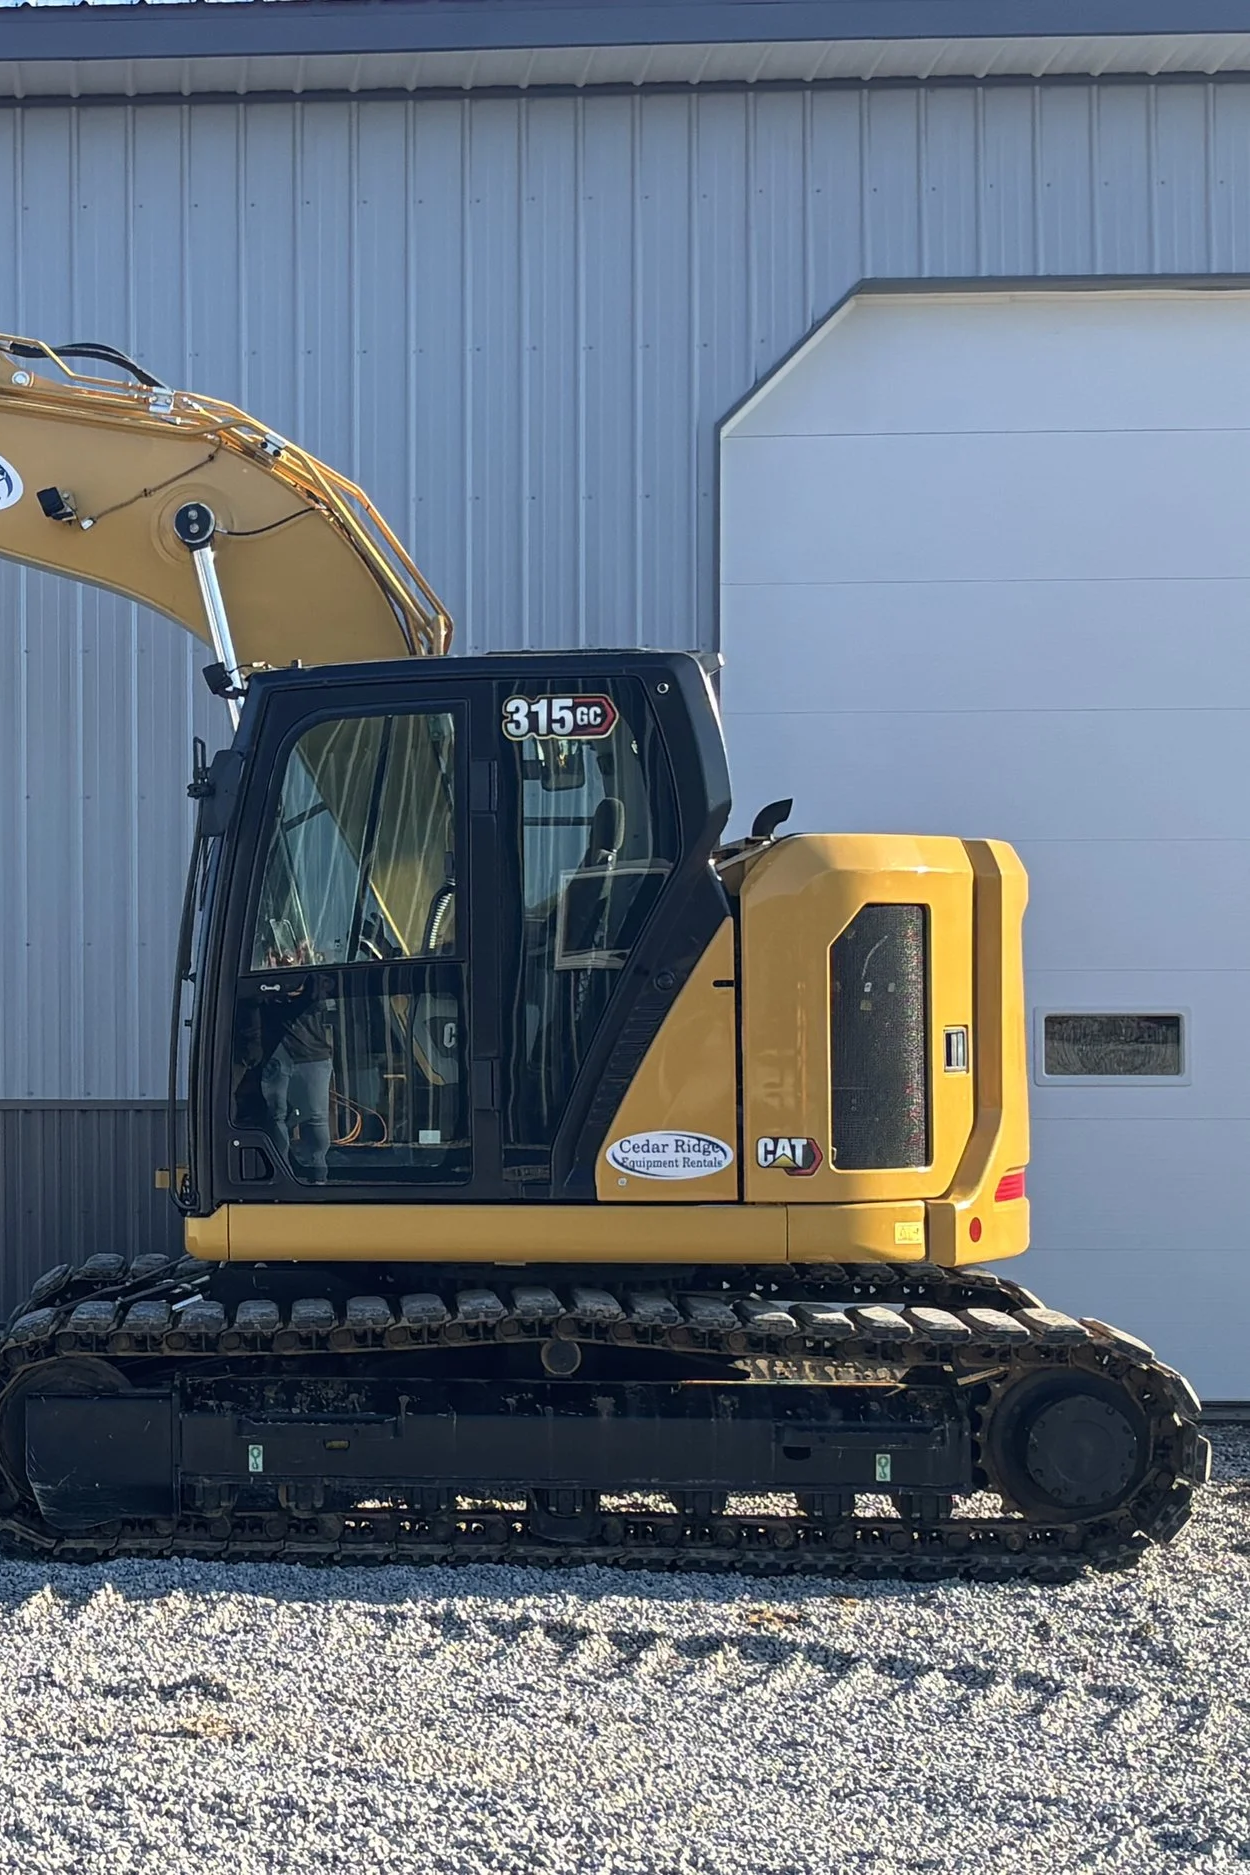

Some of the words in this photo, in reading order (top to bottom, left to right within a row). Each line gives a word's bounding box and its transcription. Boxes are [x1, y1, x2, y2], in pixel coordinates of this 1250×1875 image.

[506, 698, 574, 736] 315
[576, 706, 602, 726] GC
[619, 1138, 669, 1154] Cedar
[674, 1138, 720, 1157] Ridge
[757, 1137, 808, 1168] CAT
[621, 1156, 679, 1171] Equipment
[682, 1156, 723, 1169] Rentals
